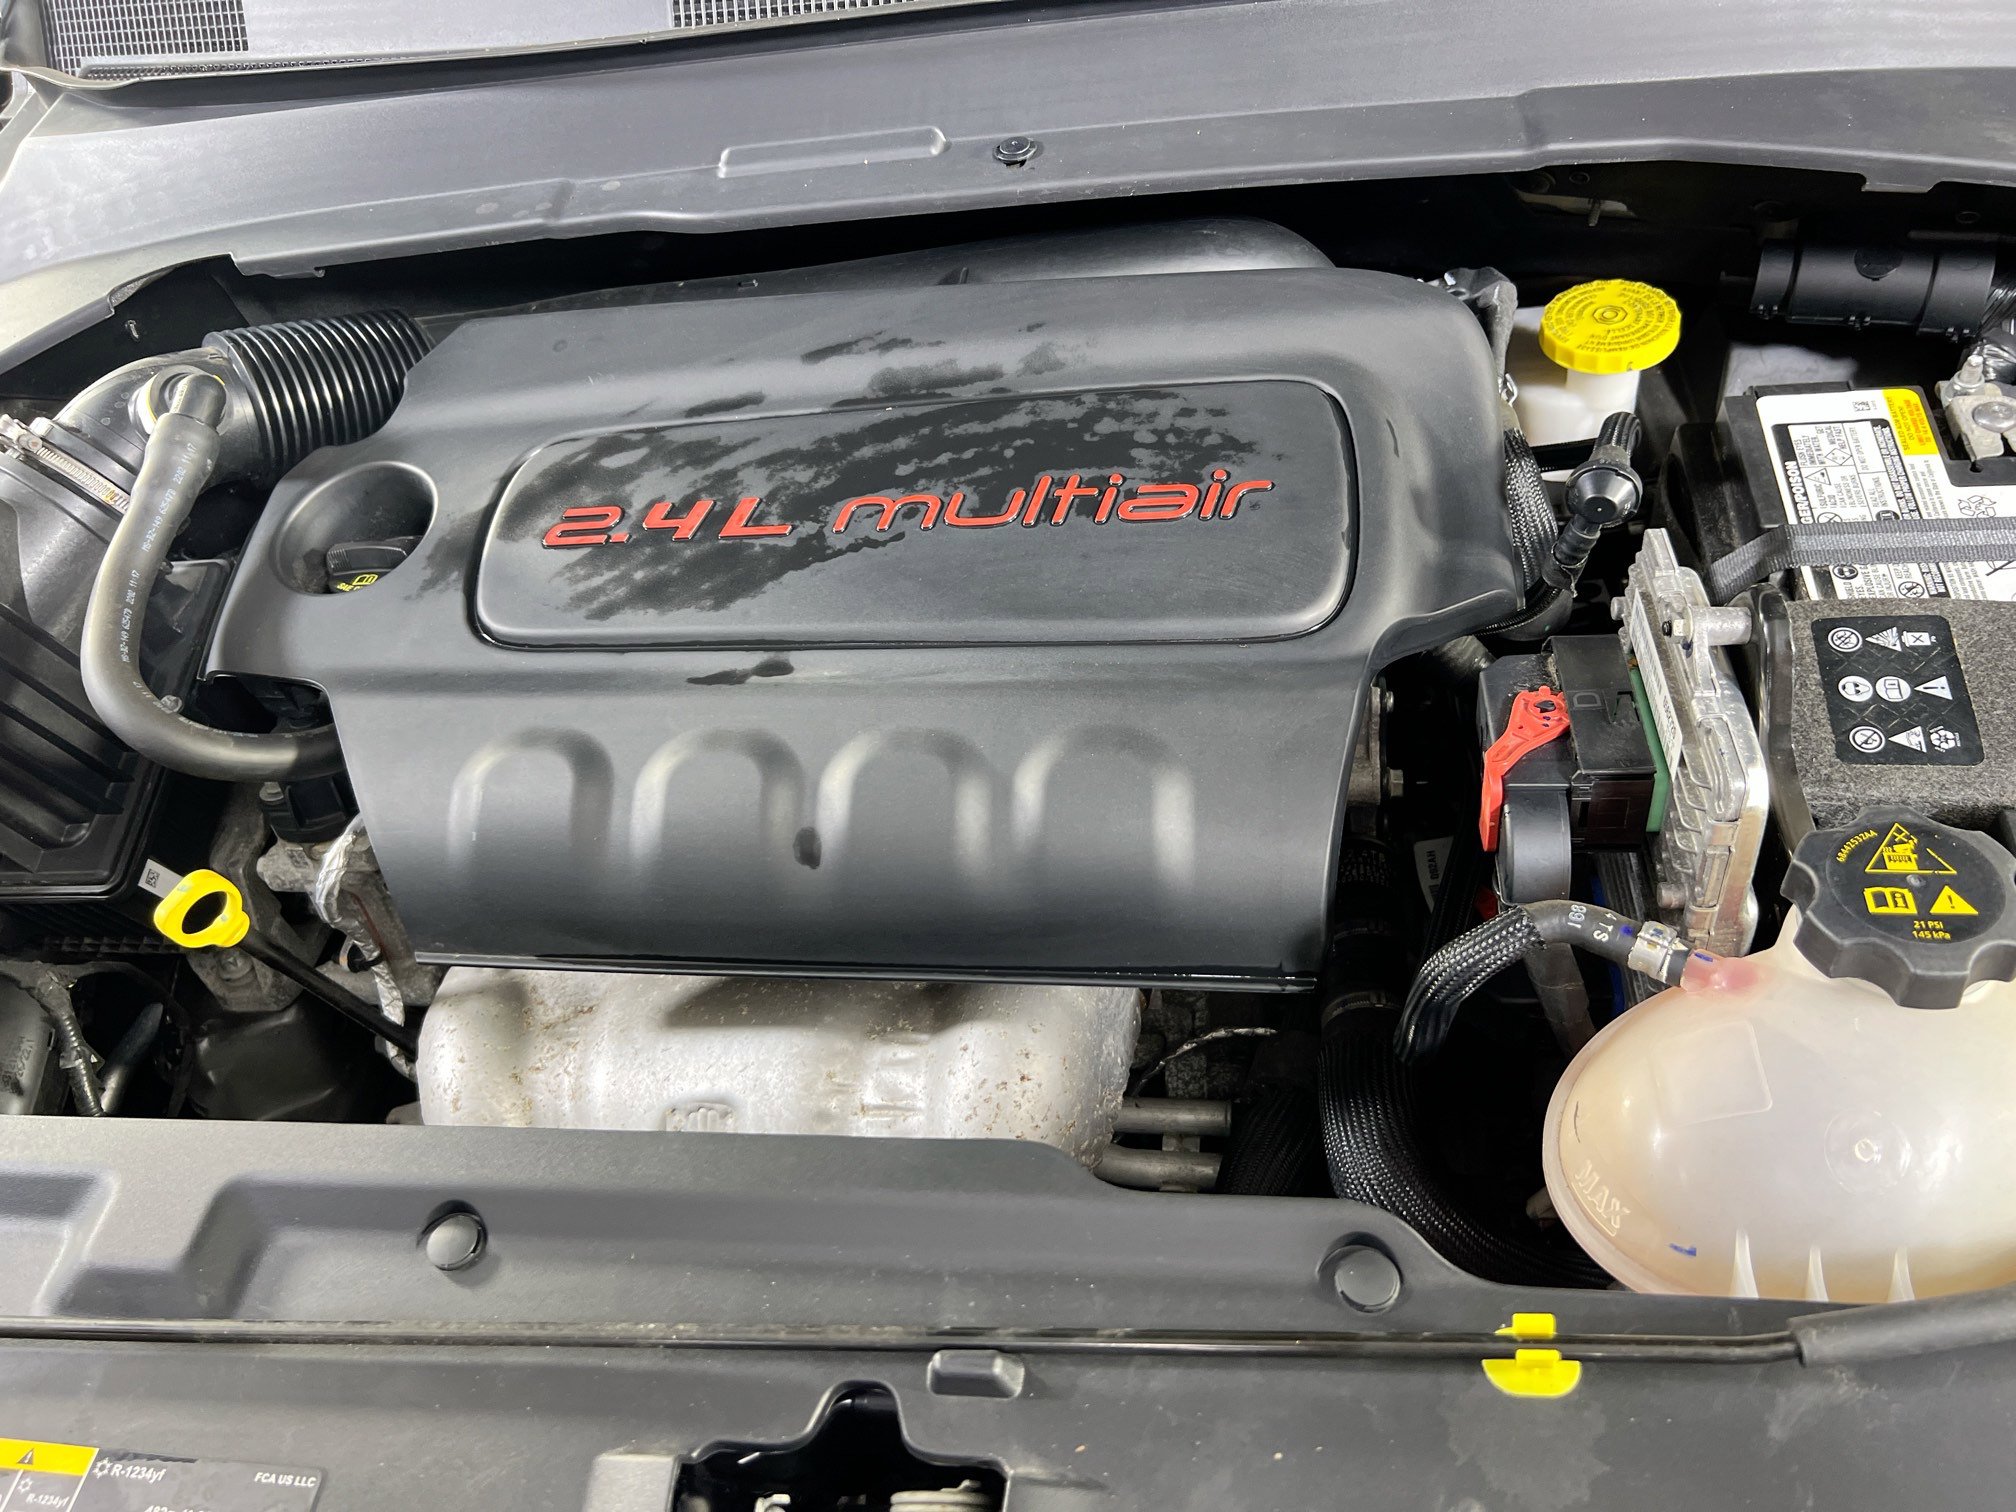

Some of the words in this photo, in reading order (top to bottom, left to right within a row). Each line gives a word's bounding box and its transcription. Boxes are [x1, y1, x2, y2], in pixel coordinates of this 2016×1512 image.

[1886, 396, 1898, 417] BATTERY
[1792, 439, 1804, 450] EYES
[1800, 435, 1817, 465] IMMEDIATELY
[1897, 430, 1910, 450] SEALED
[1796, 451, 1808, 465] FLUSH
[832, 468, 1275, 533] multiair
[1913, 920, 1927, 930] 21
[1928, 920, 1944, 930] PSI
[1912, 931, 1931, 940] 145
[1932, 931, 1951, 940] kPa
[1574, 1160, 1632, 1228] MAX
[110, 1463, 167, 1484] R-1234yf
[254, 1471, 278, 1483] FCA
[277, 1474, 294, 1485] US
[294, 1475, 317, 1488] LLC
